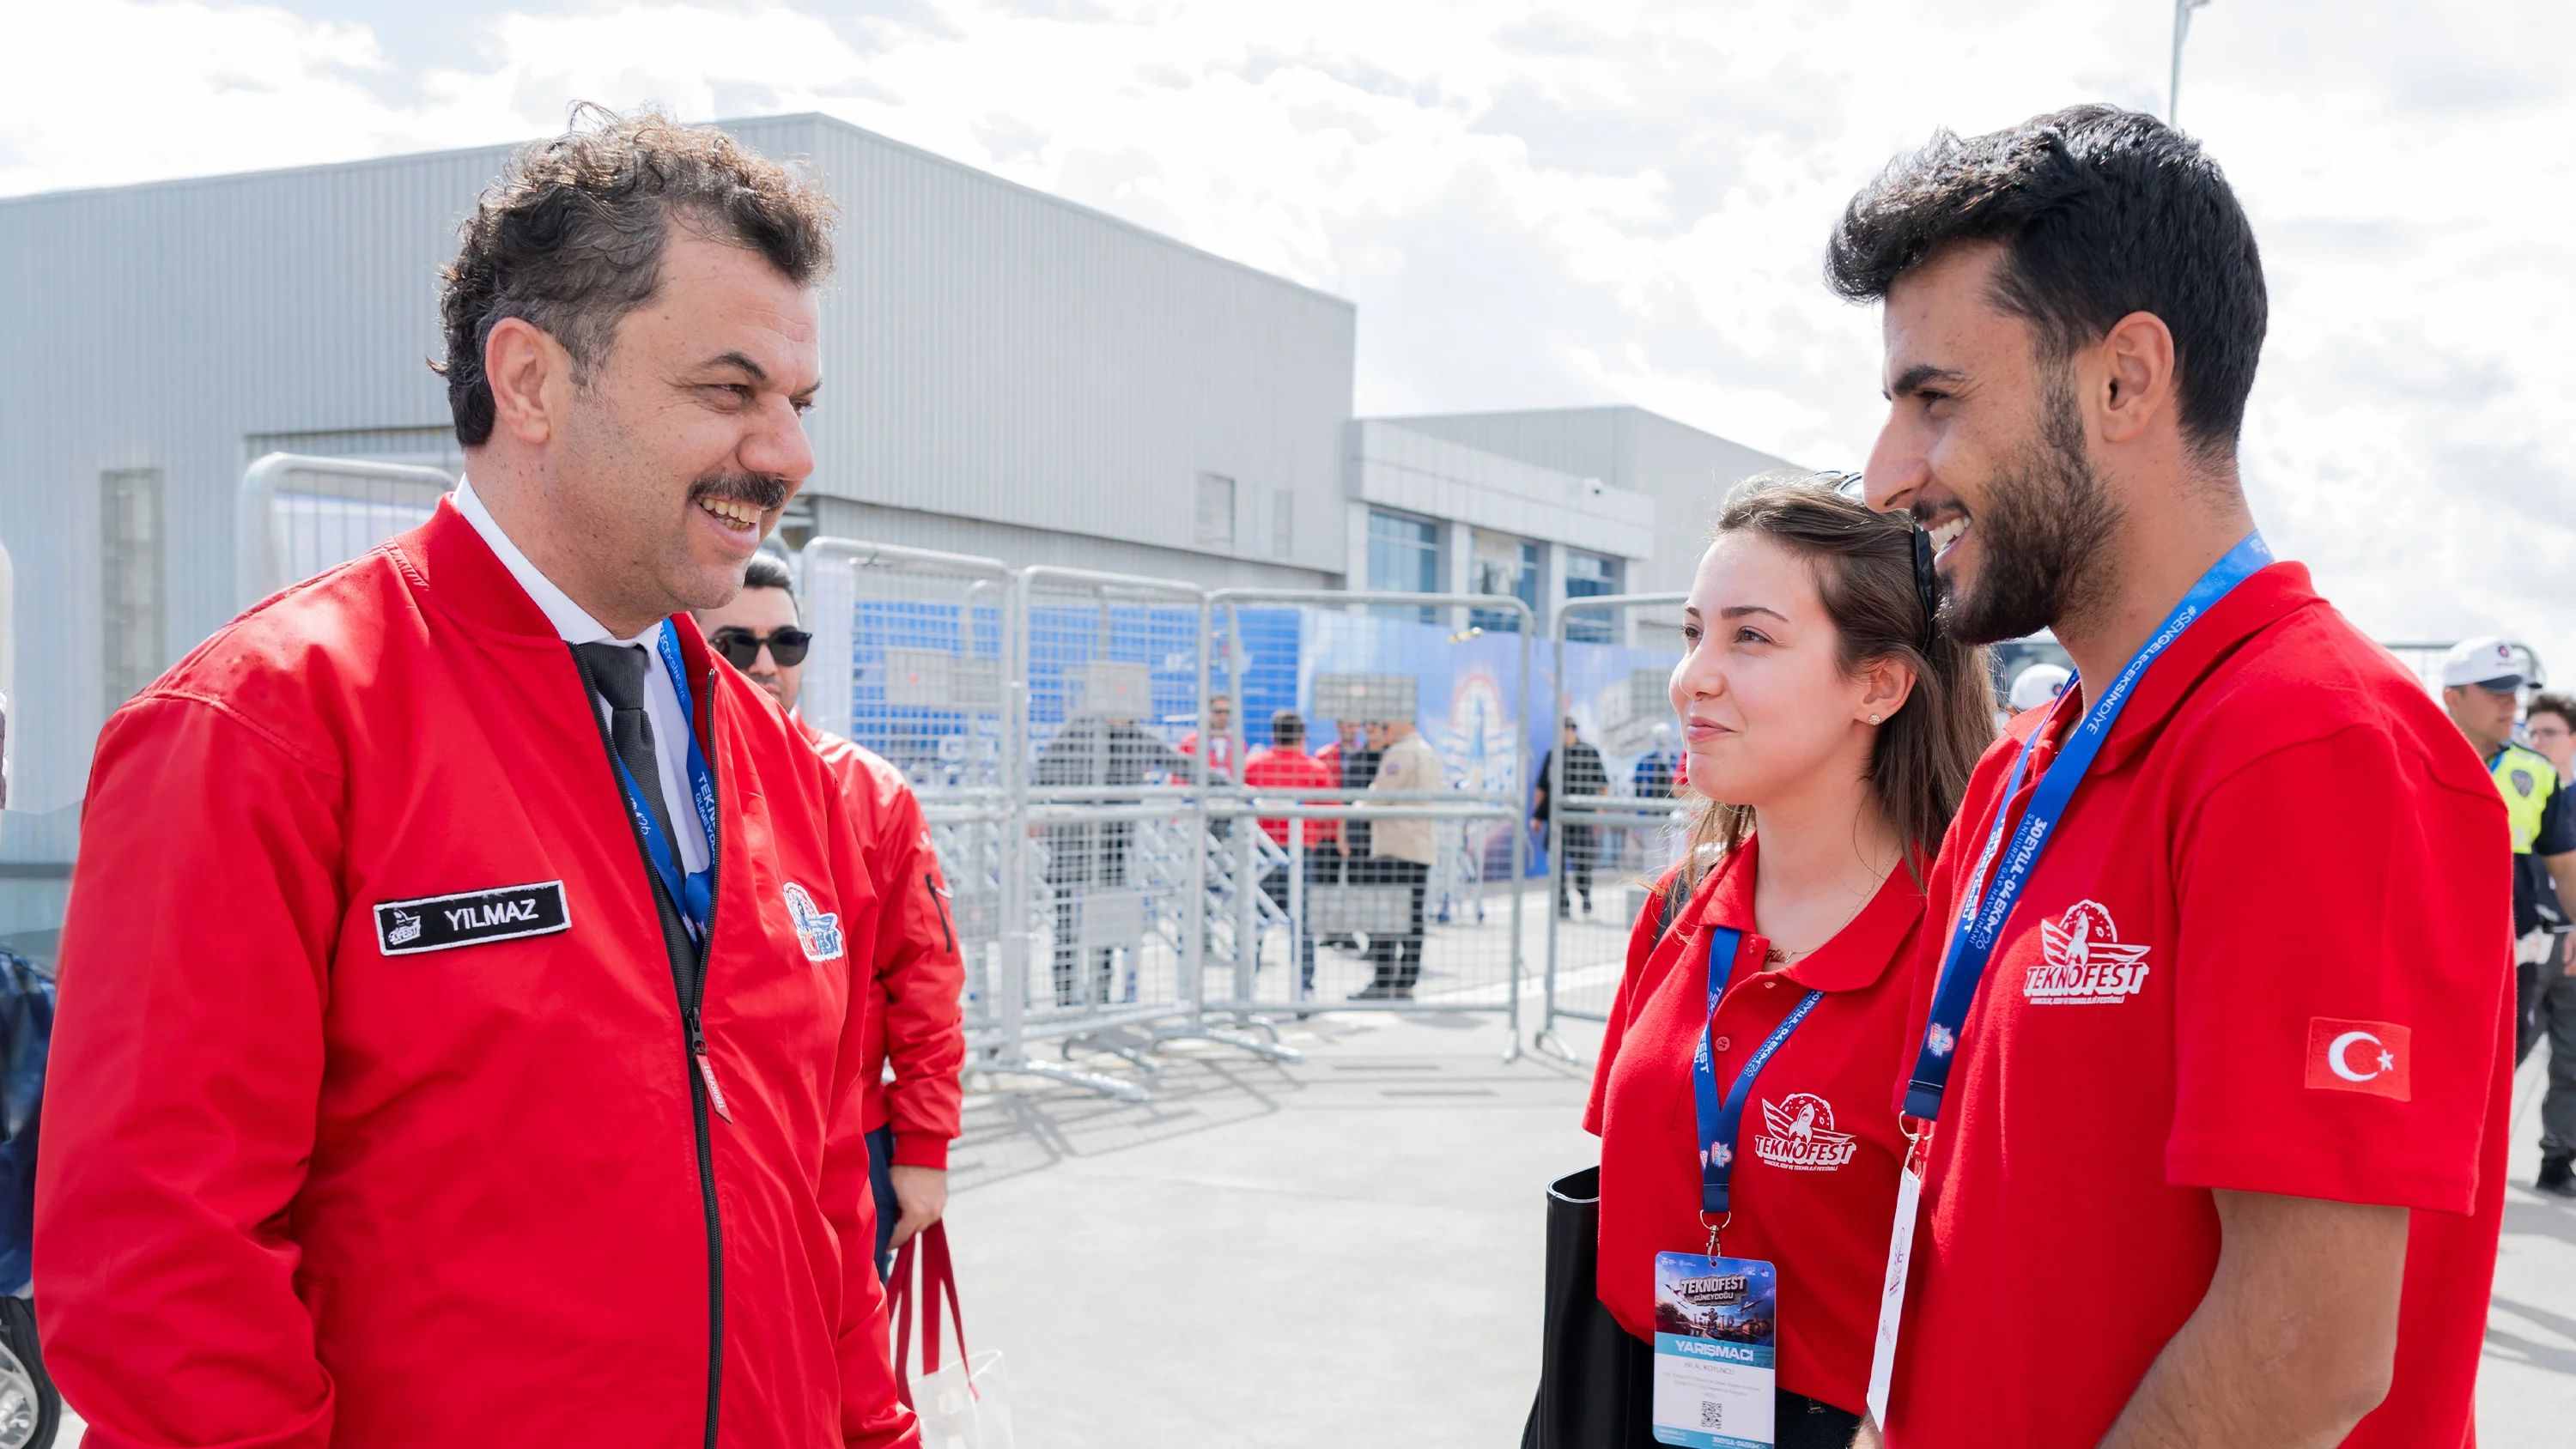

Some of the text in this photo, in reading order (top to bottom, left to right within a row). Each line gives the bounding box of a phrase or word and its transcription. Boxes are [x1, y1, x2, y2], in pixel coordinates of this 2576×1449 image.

[2087, 604, 2197, 735] #SENGELECEKSİNDİYE
[1996, 867, 2008, 887] GAP
[444, 899, 539, 931] YILMAZ
[2023, 962, 2149, 996] TEKNOFEST
[704, 1064, 725, 1109] TEKNOFEST
[1755, 1134, 1856, 1165] TEKNOFEST
[1680, 1275, 1746, 1294] TEKNOFEST
[1694, 1291, 1734, 1302] GÜNEYDOĞU
[1675, 1339, 1754, 1361] YARIŞMACI
